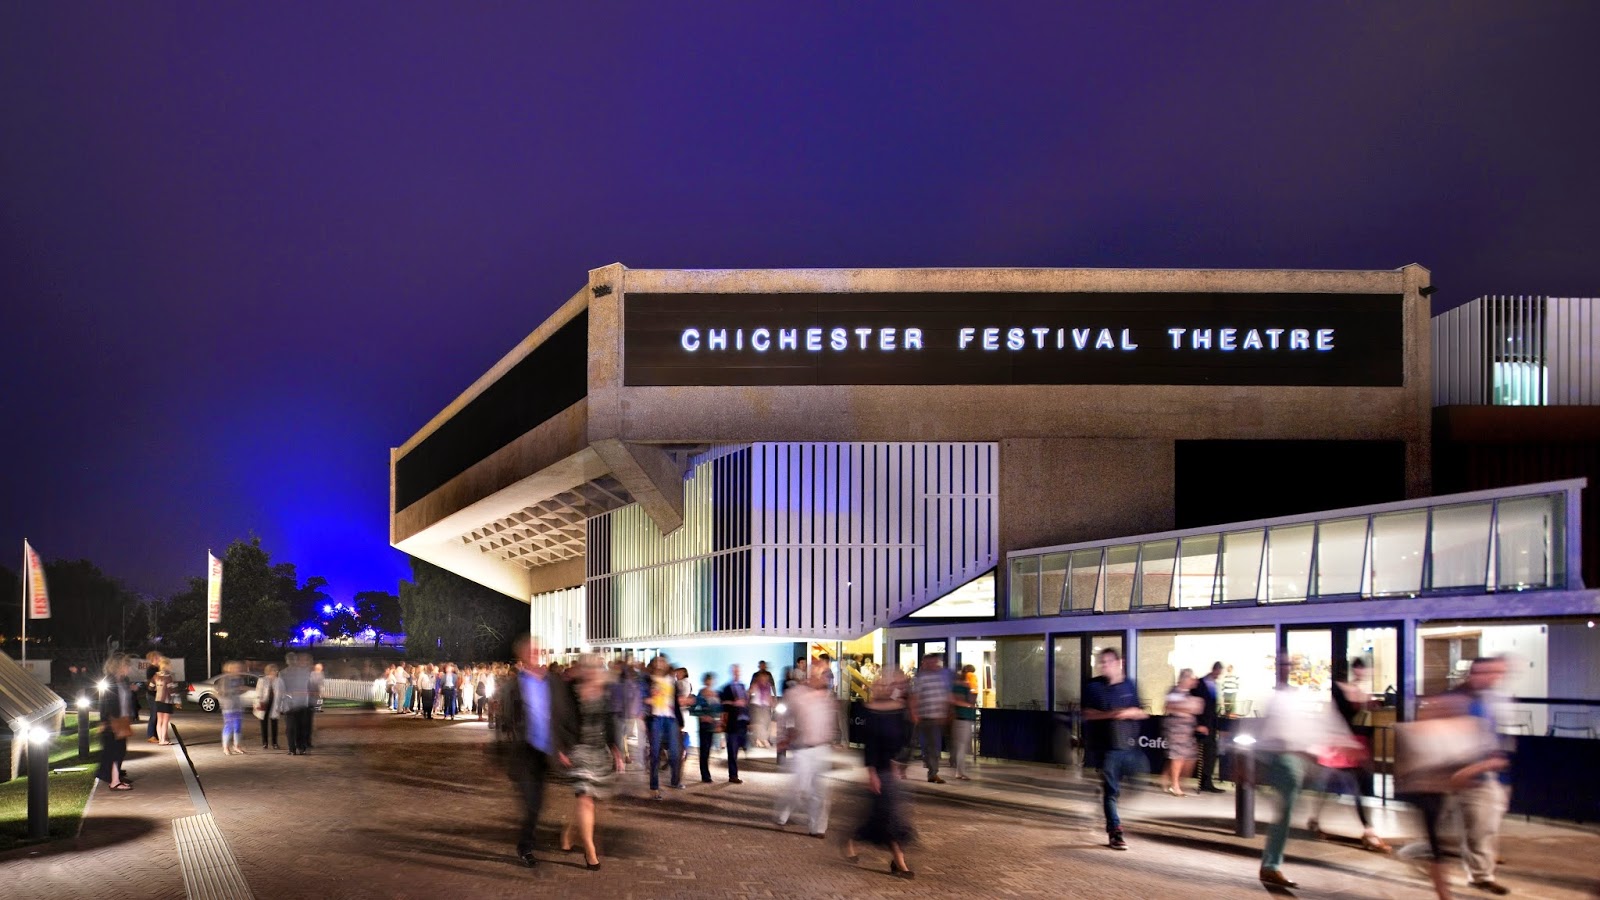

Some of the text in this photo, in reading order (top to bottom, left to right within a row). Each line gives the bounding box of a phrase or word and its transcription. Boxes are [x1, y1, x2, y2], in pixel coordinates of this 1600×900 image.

[681, 328, 1335, 351] CHICHESTER FESTIVAL THEATRE
[1138, 735, 1169, 749] Café
